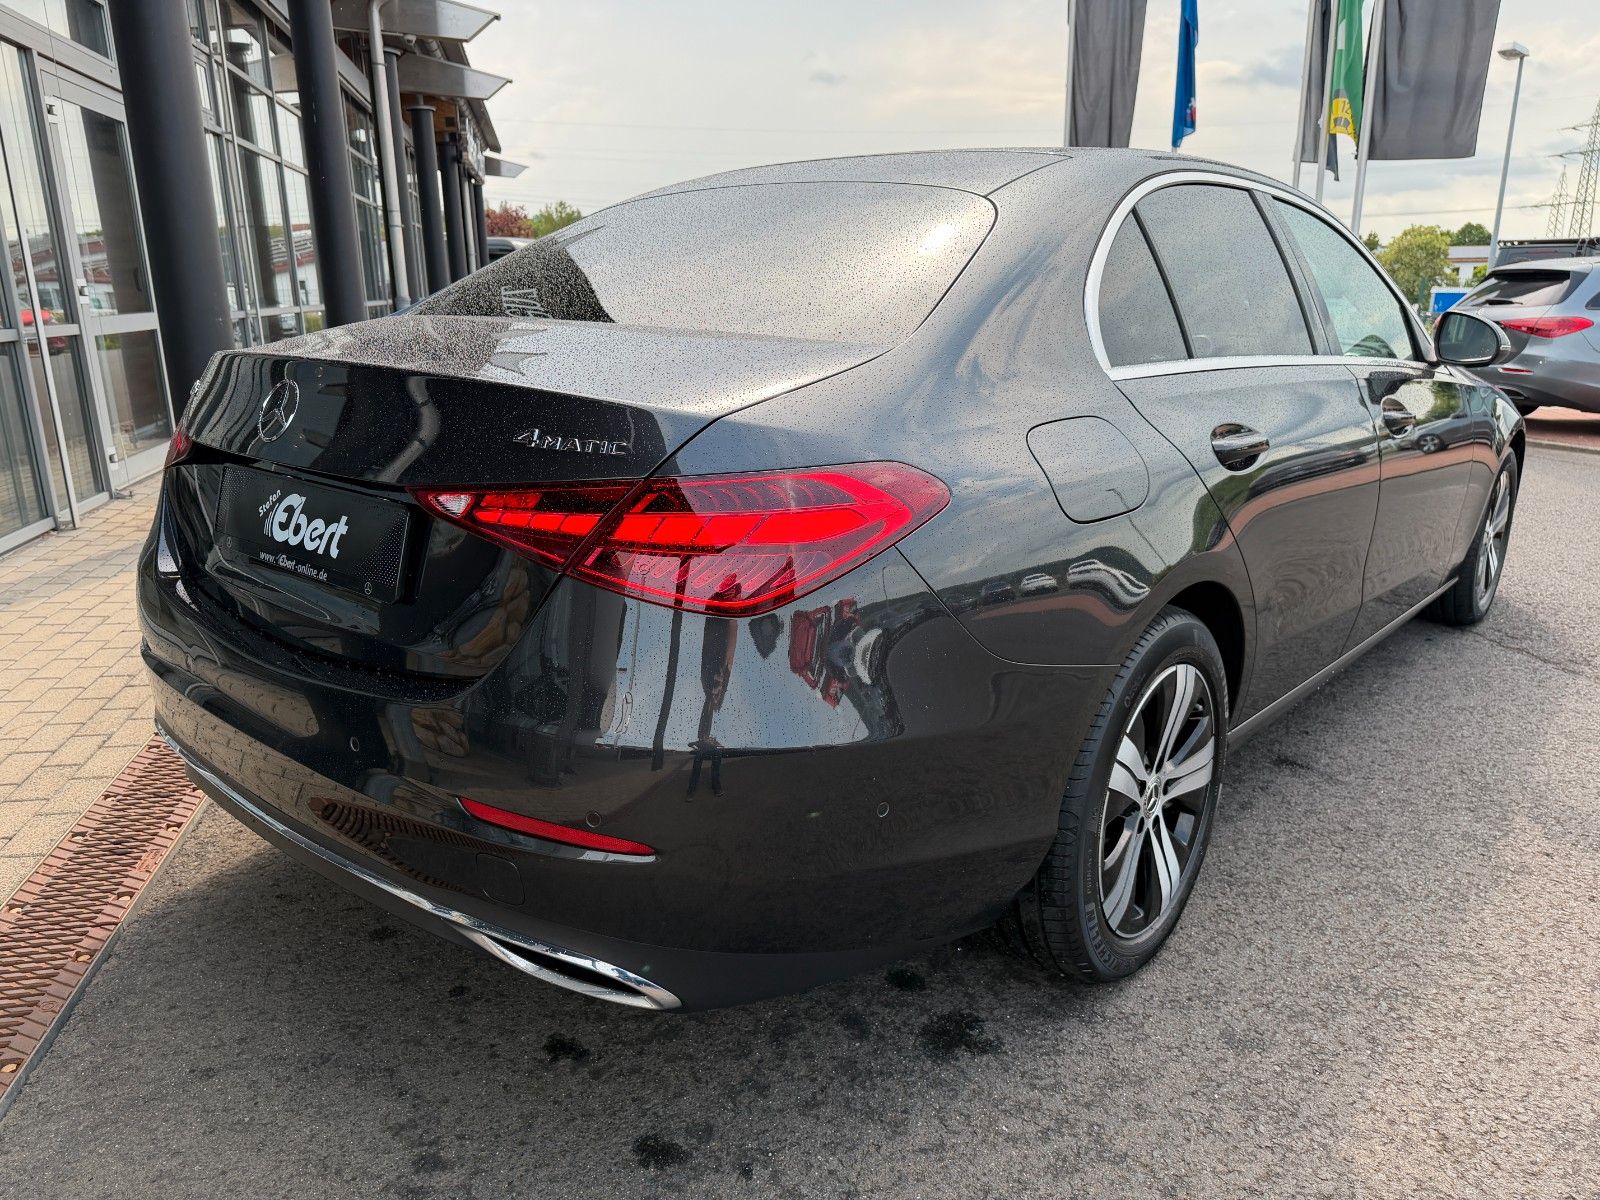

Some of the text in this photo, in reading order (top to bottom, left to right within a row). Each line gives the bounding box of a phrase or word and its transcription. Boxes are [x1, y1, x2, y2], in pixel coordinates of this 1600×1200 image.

[513, 428, 627, 455] 4MATIC
[258, 489, 281, 517] Stefan
[270, 493, 349, 559] Ebert
